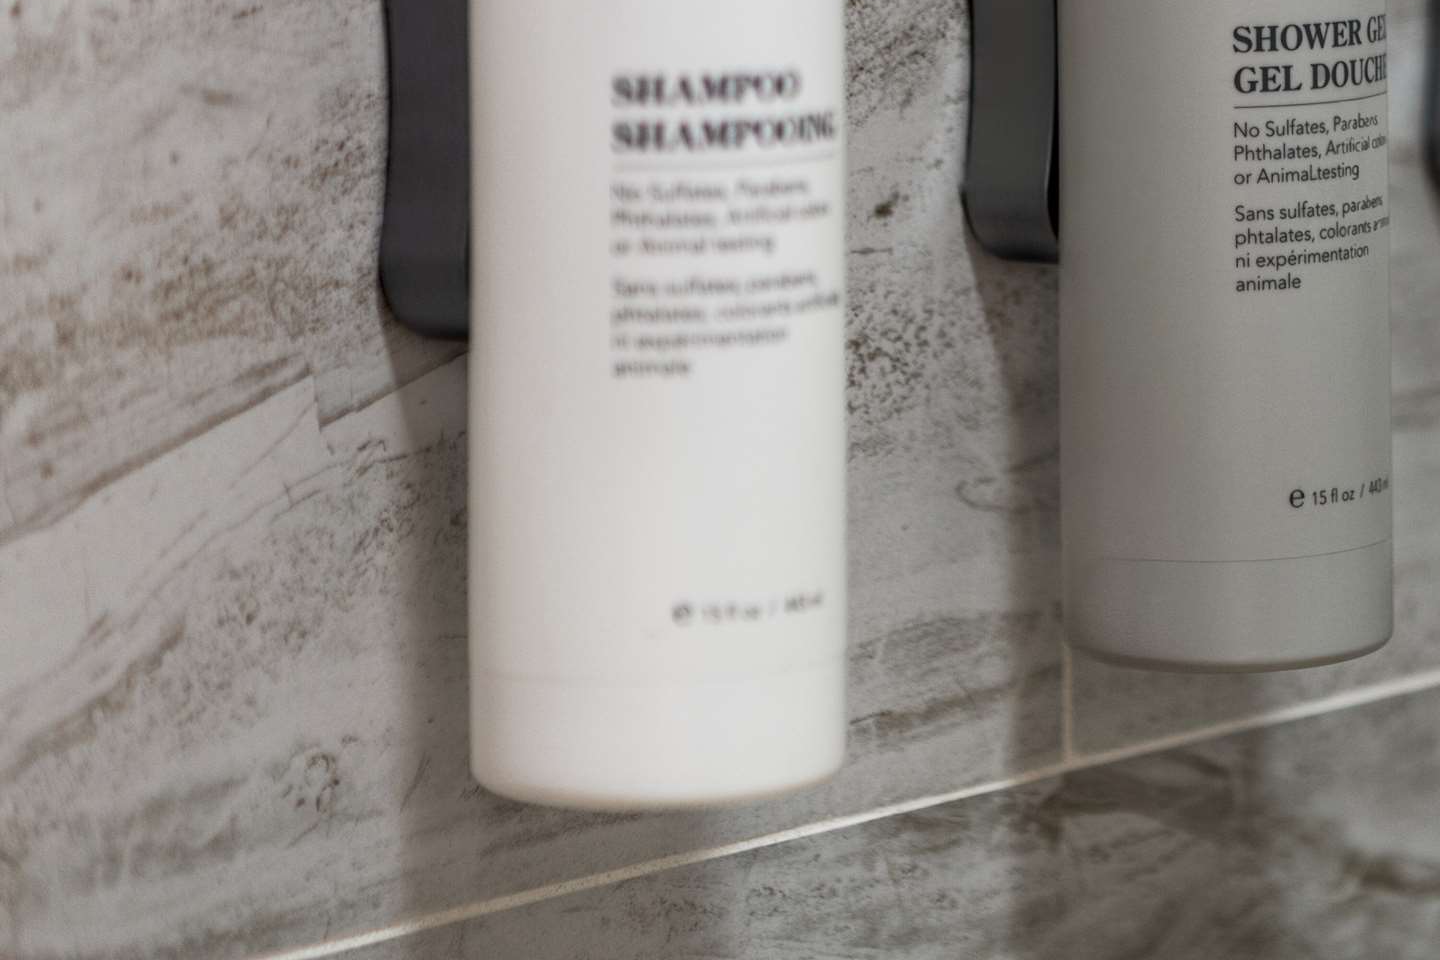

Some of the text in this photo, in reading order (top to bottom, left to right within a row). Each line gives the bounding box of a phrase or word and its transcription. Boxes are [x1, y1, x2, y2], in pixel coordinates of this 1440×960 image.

[1232, 19, 1362, 53] SHOWER
[611, 70, 802, 107] SHAMPOO
[1233, 65, 1303, 94] GEL
[611, 111, 835, 153] SHAMPOOING
[1233, 122, 1260, 138] No
[1265, 118, 1329, 137] Sulfates,
[1234, 142, 1322, 162] Phthalates,
[1324, 136, 1370, 157] Artificial
[1233, 172, 1252, 185] or
[1234, 204, 1275, 222] Sans
[1279, 200, 1338, 220] sulfates,
[1235, 226, 1315, 248] phtalates,
[1319, 220, 1371, 241] colorants
[1236, 244, 1369, 271] ni expérimentation
[1236, 272, 1302, 292] animale
[1312, 490, 1328, 506] 15
[1341, 490, 1355, 502] oz
